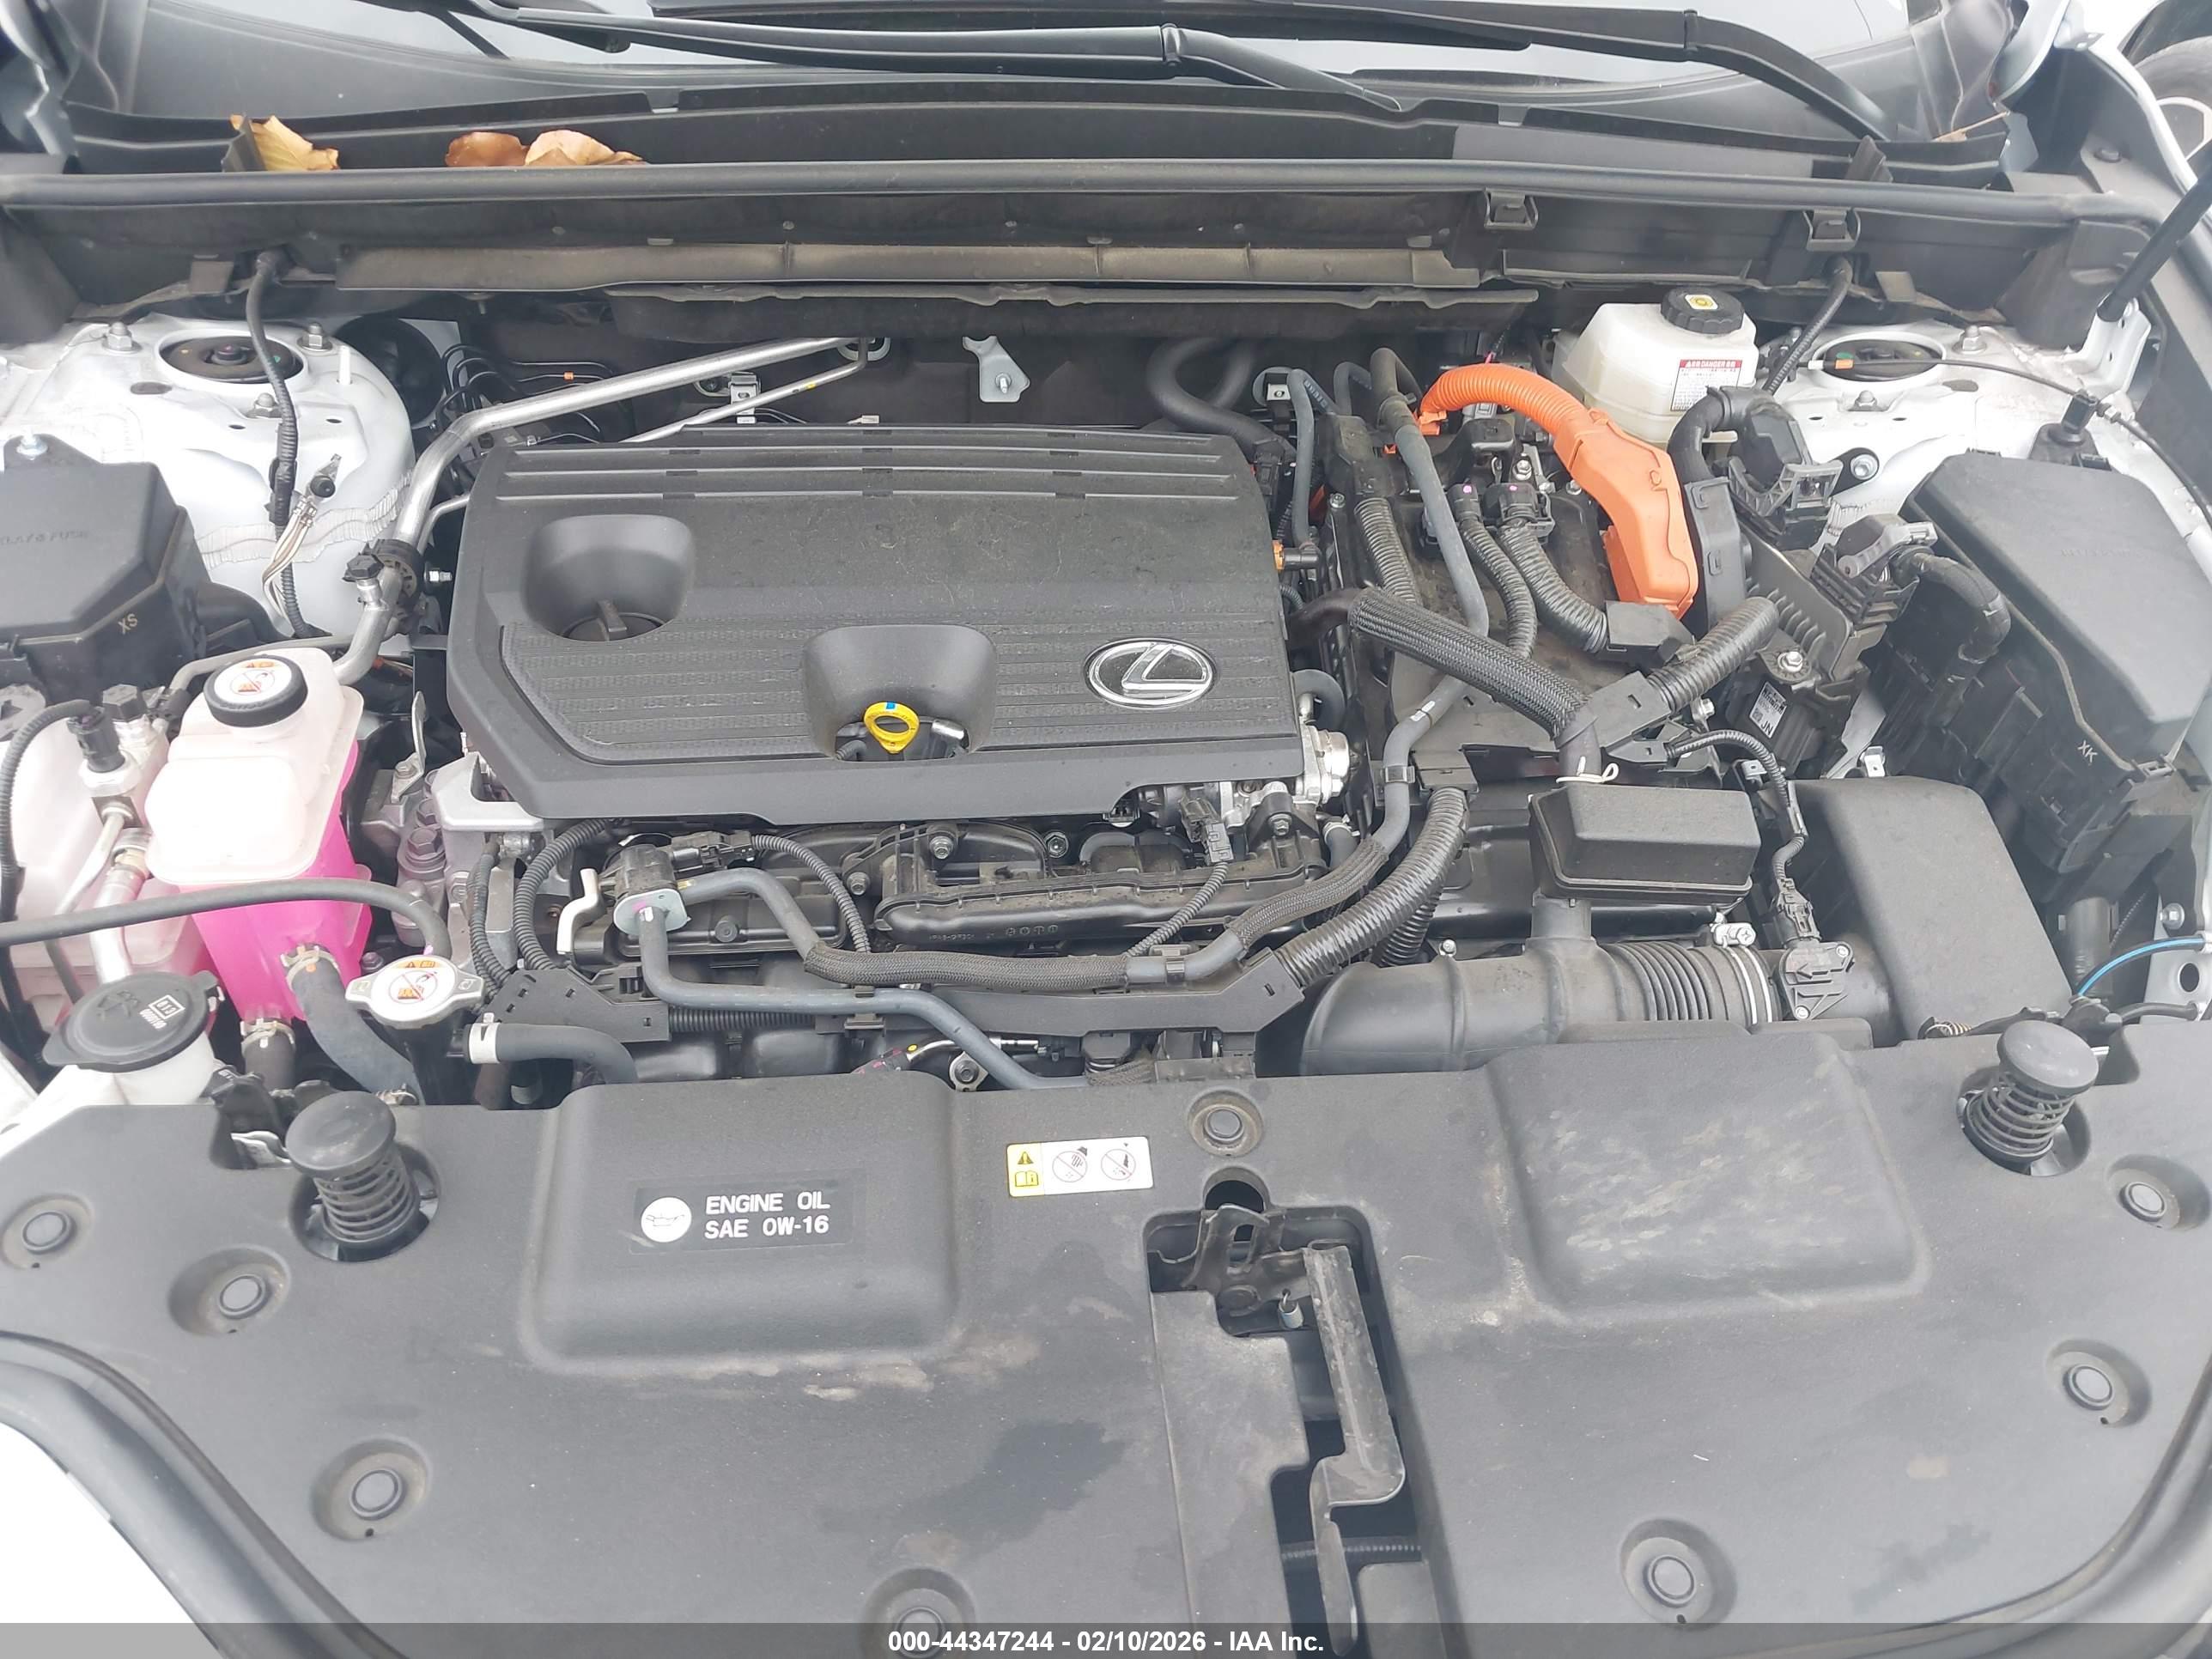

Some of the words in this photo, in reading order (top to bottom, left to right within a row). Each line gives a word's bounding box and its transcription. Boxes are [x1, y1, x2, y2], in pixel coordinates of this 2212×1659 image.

[118, 613, 137, 635] XS
[1760, 720, 1774, 736] JN
[706, 1193, 784, 1214] ENGINE
[797, 1191, 831, 1210] OIL
[704, 1218, 750, 1239] SAE
[763, 1215, 830, 1237] 0W-16
